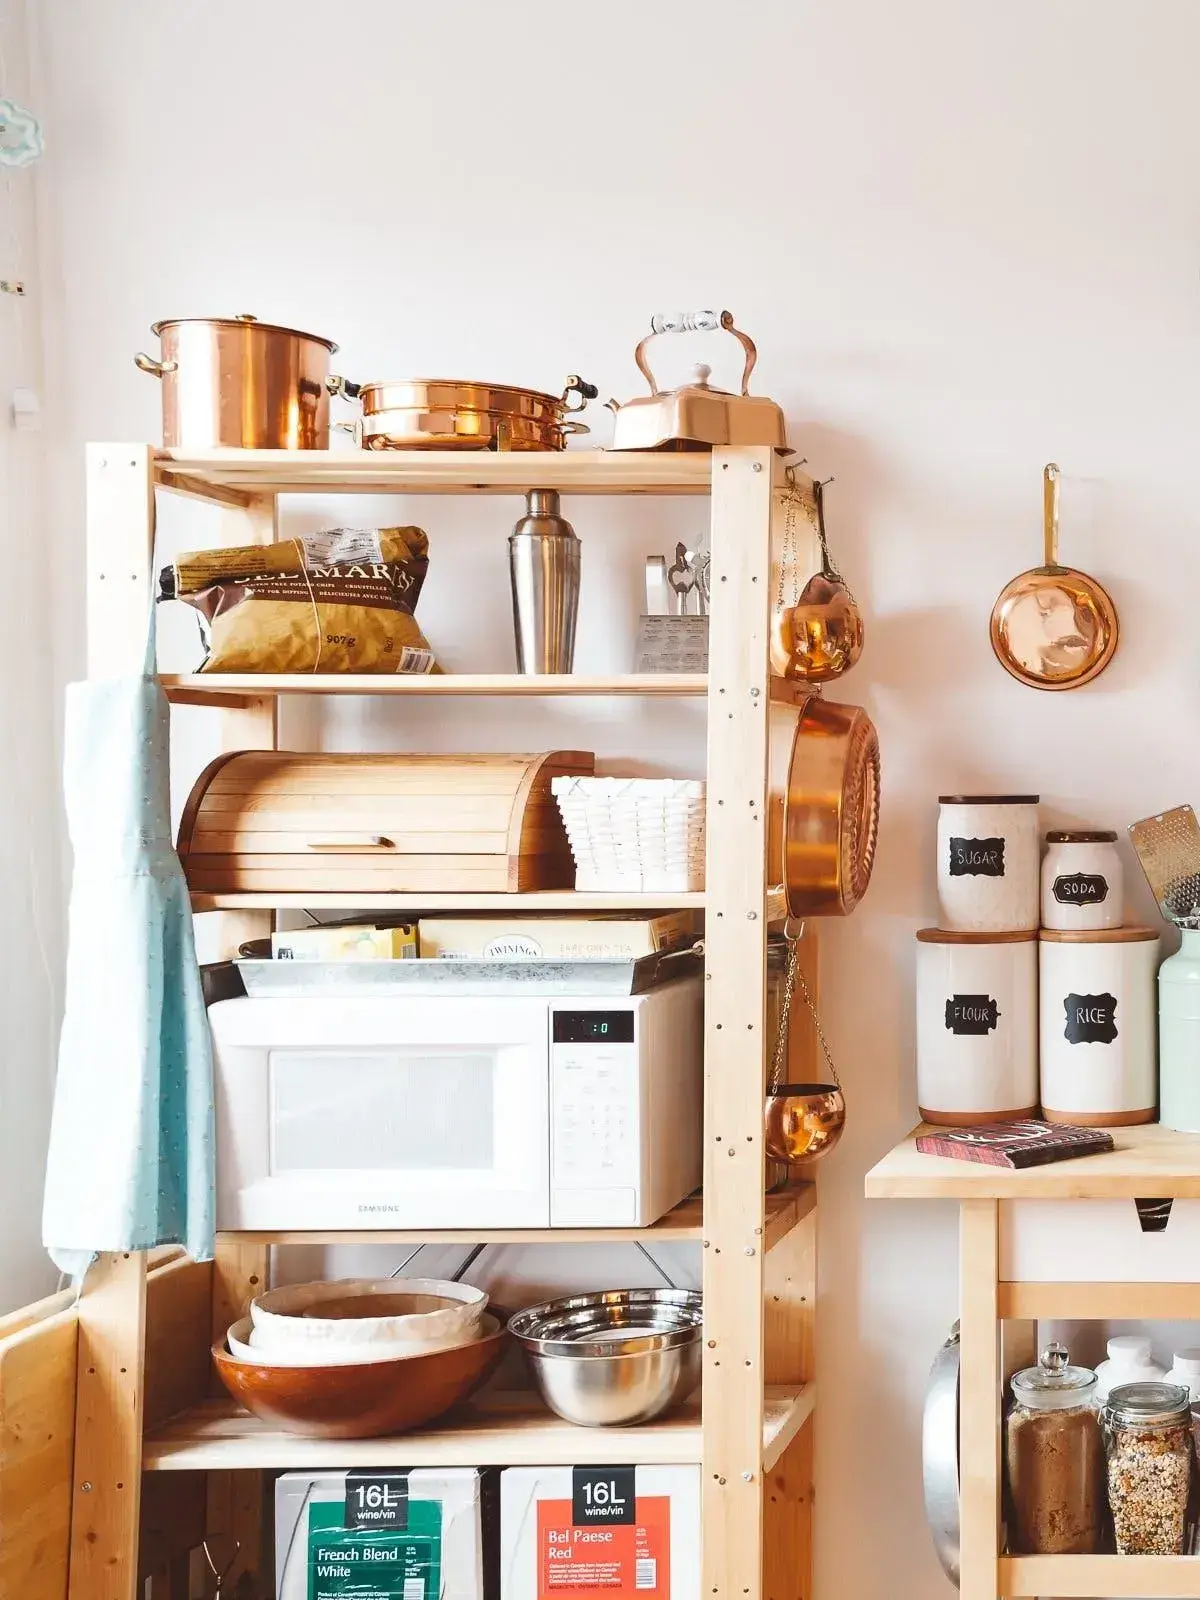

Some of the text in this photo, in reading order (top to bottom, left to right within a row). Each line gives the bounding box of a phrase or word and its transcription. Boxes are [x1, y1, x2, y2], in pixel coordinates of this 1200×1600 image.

[957, 848, 999, 868] SUGAR
[1063, 882, 1096, 896] SODA
[954, 1006, 989, 1022] FLOUR
[1075, 1007, 1106, 1024] RICE
[355, 1483, 398, 1508] 16L
[582, 1480, 626, 1505] 16L
[357, 1509, 396, 1520] wine/vin
[585, 1506, 624, 1516] wine/vin
[549, 1530, 613, 1543] Bel Paese
[318, 1548, 359, 1561] French
[363, 1547, 398, 1561] Blend
[549, 1547, 572, 1559] Red
[317, 1566, 351, 1577] White
